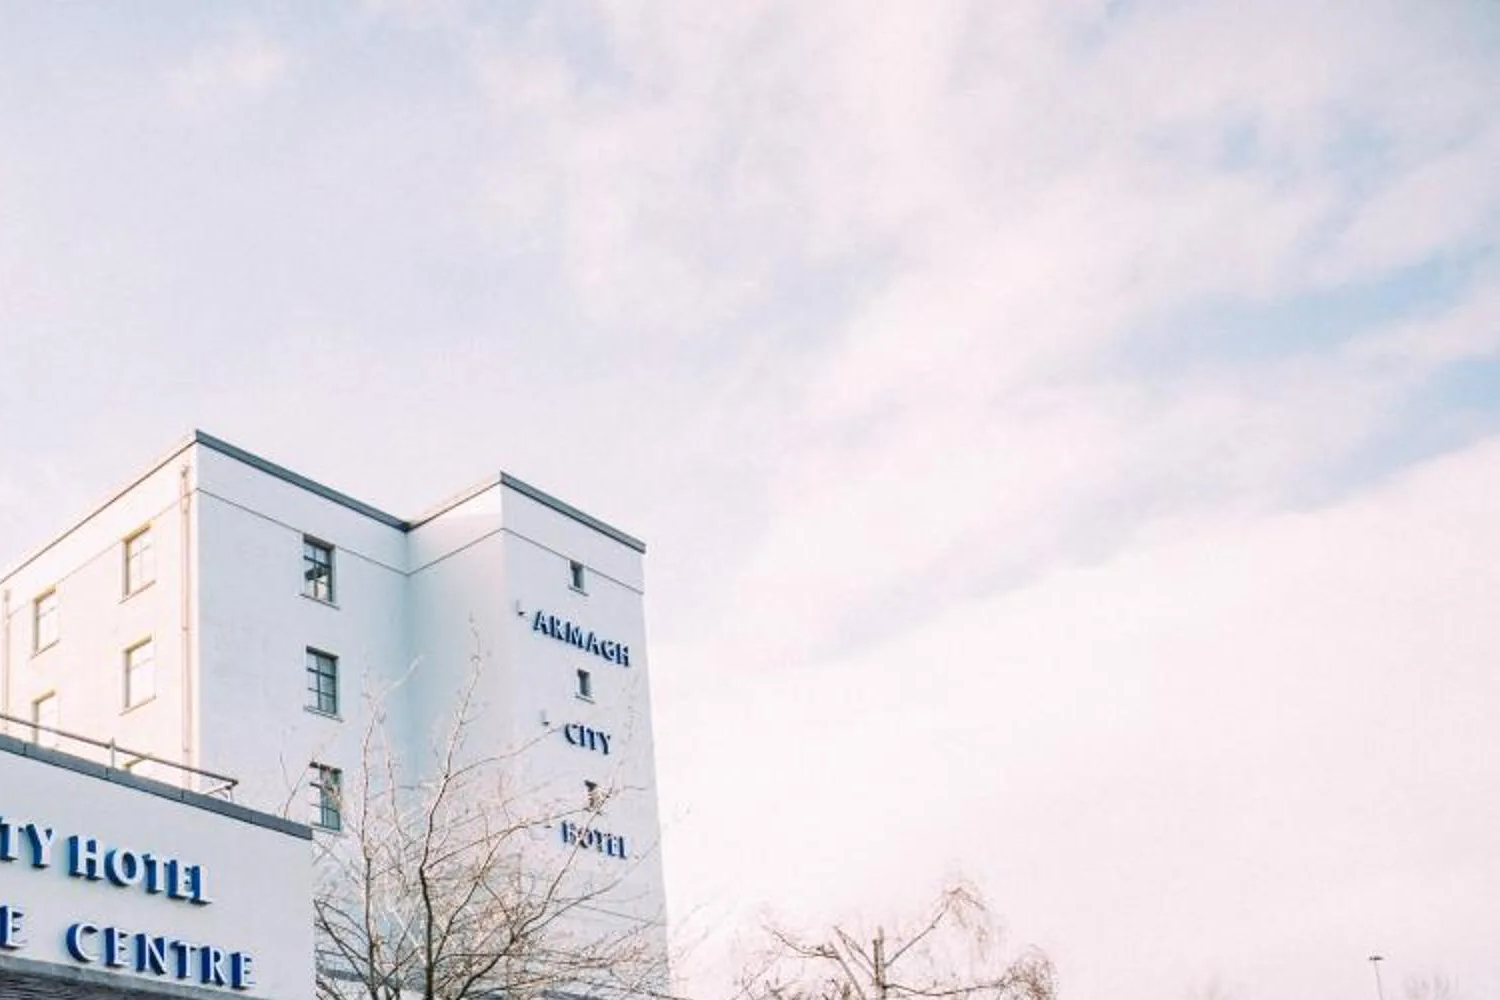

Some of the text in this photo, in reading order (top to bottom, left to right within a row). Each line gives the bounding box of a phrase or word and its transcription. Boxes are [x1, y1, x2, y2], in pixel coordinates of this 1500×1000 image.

[533, 611, 630, 668] ARMAGH
[564, 723, 611, 756] CITY
[561, 819, 628, 860] HOTEL
[68, 834, 213, 905] HOTEL
[67, 922, 257, 989] CENTRE
